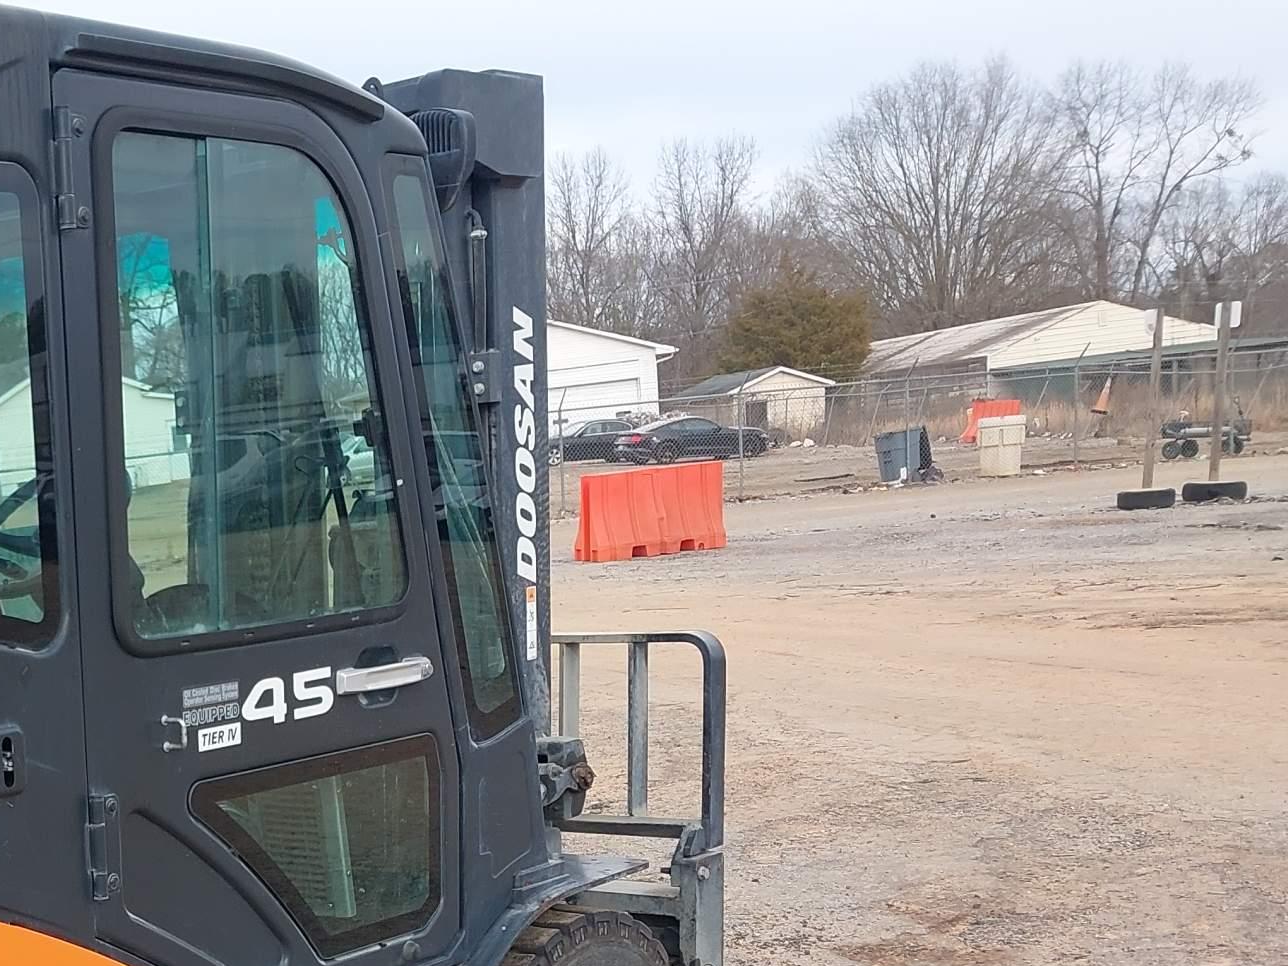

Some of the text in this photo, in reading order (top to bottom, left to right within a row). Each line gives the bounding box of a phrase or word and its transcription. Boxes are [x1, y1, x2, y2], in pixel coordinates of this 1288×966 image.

[512, 306, 537, 583] DOOSAN
[182, 702, 240, 727] EQUIPPED
[241, 666, 335, 724] 45
[202, 727, 238, 747] TIER IV
